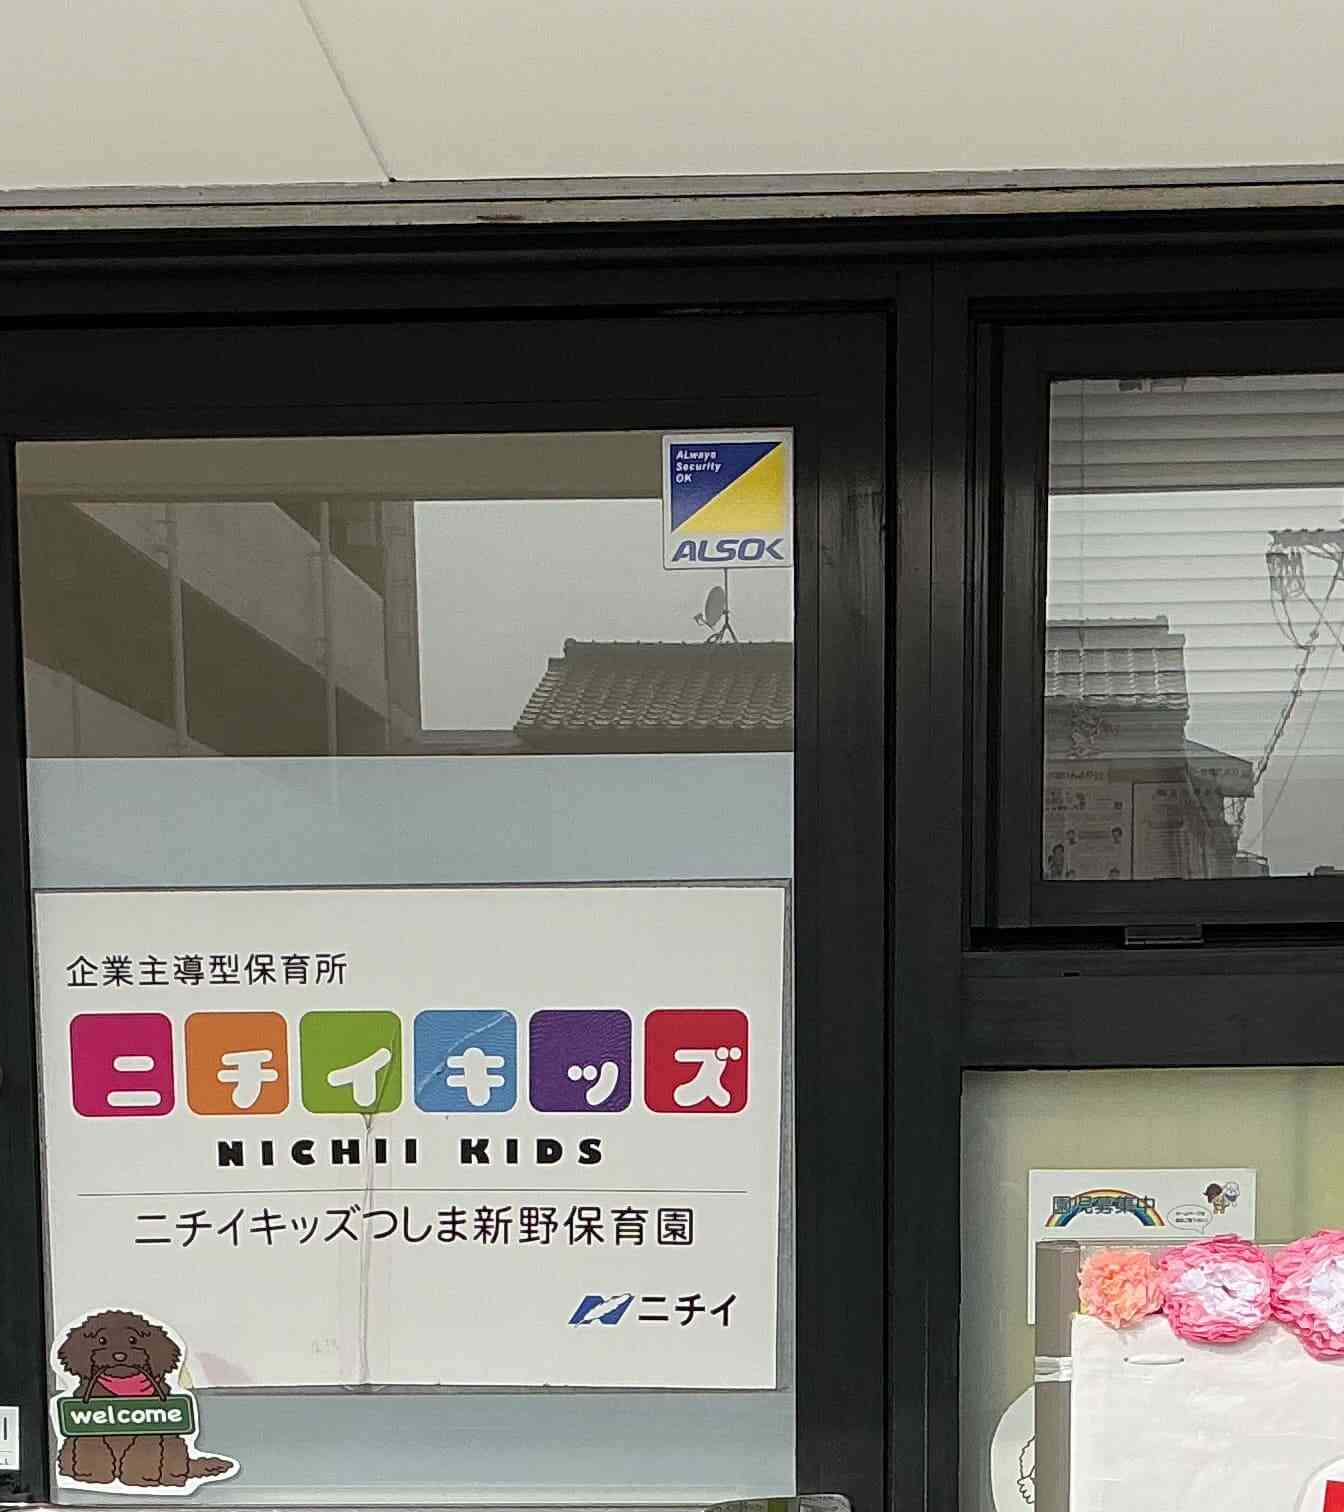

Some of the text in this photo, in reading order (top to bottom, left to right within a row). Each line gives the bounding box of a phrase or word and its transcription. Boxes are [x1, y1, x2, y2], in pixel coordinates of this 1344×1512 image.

[675, 461, 722, 473] Security
[675, 473, 693, 484] OK
[671, 538, 785, 562] ALSOK
[65, 952, 349, 987] 企業主導型保育所
[103, 1044, 745, 1111] ニチイキッズ
[217, 1137, 603, 1168] NICHII KIDS
[134, 1203, 695, 1247] ニチイキッズつしま新野保育園
[637, 1291, 739, 1328] ニチイ
[70, 1404, 184, 1425] welcome
